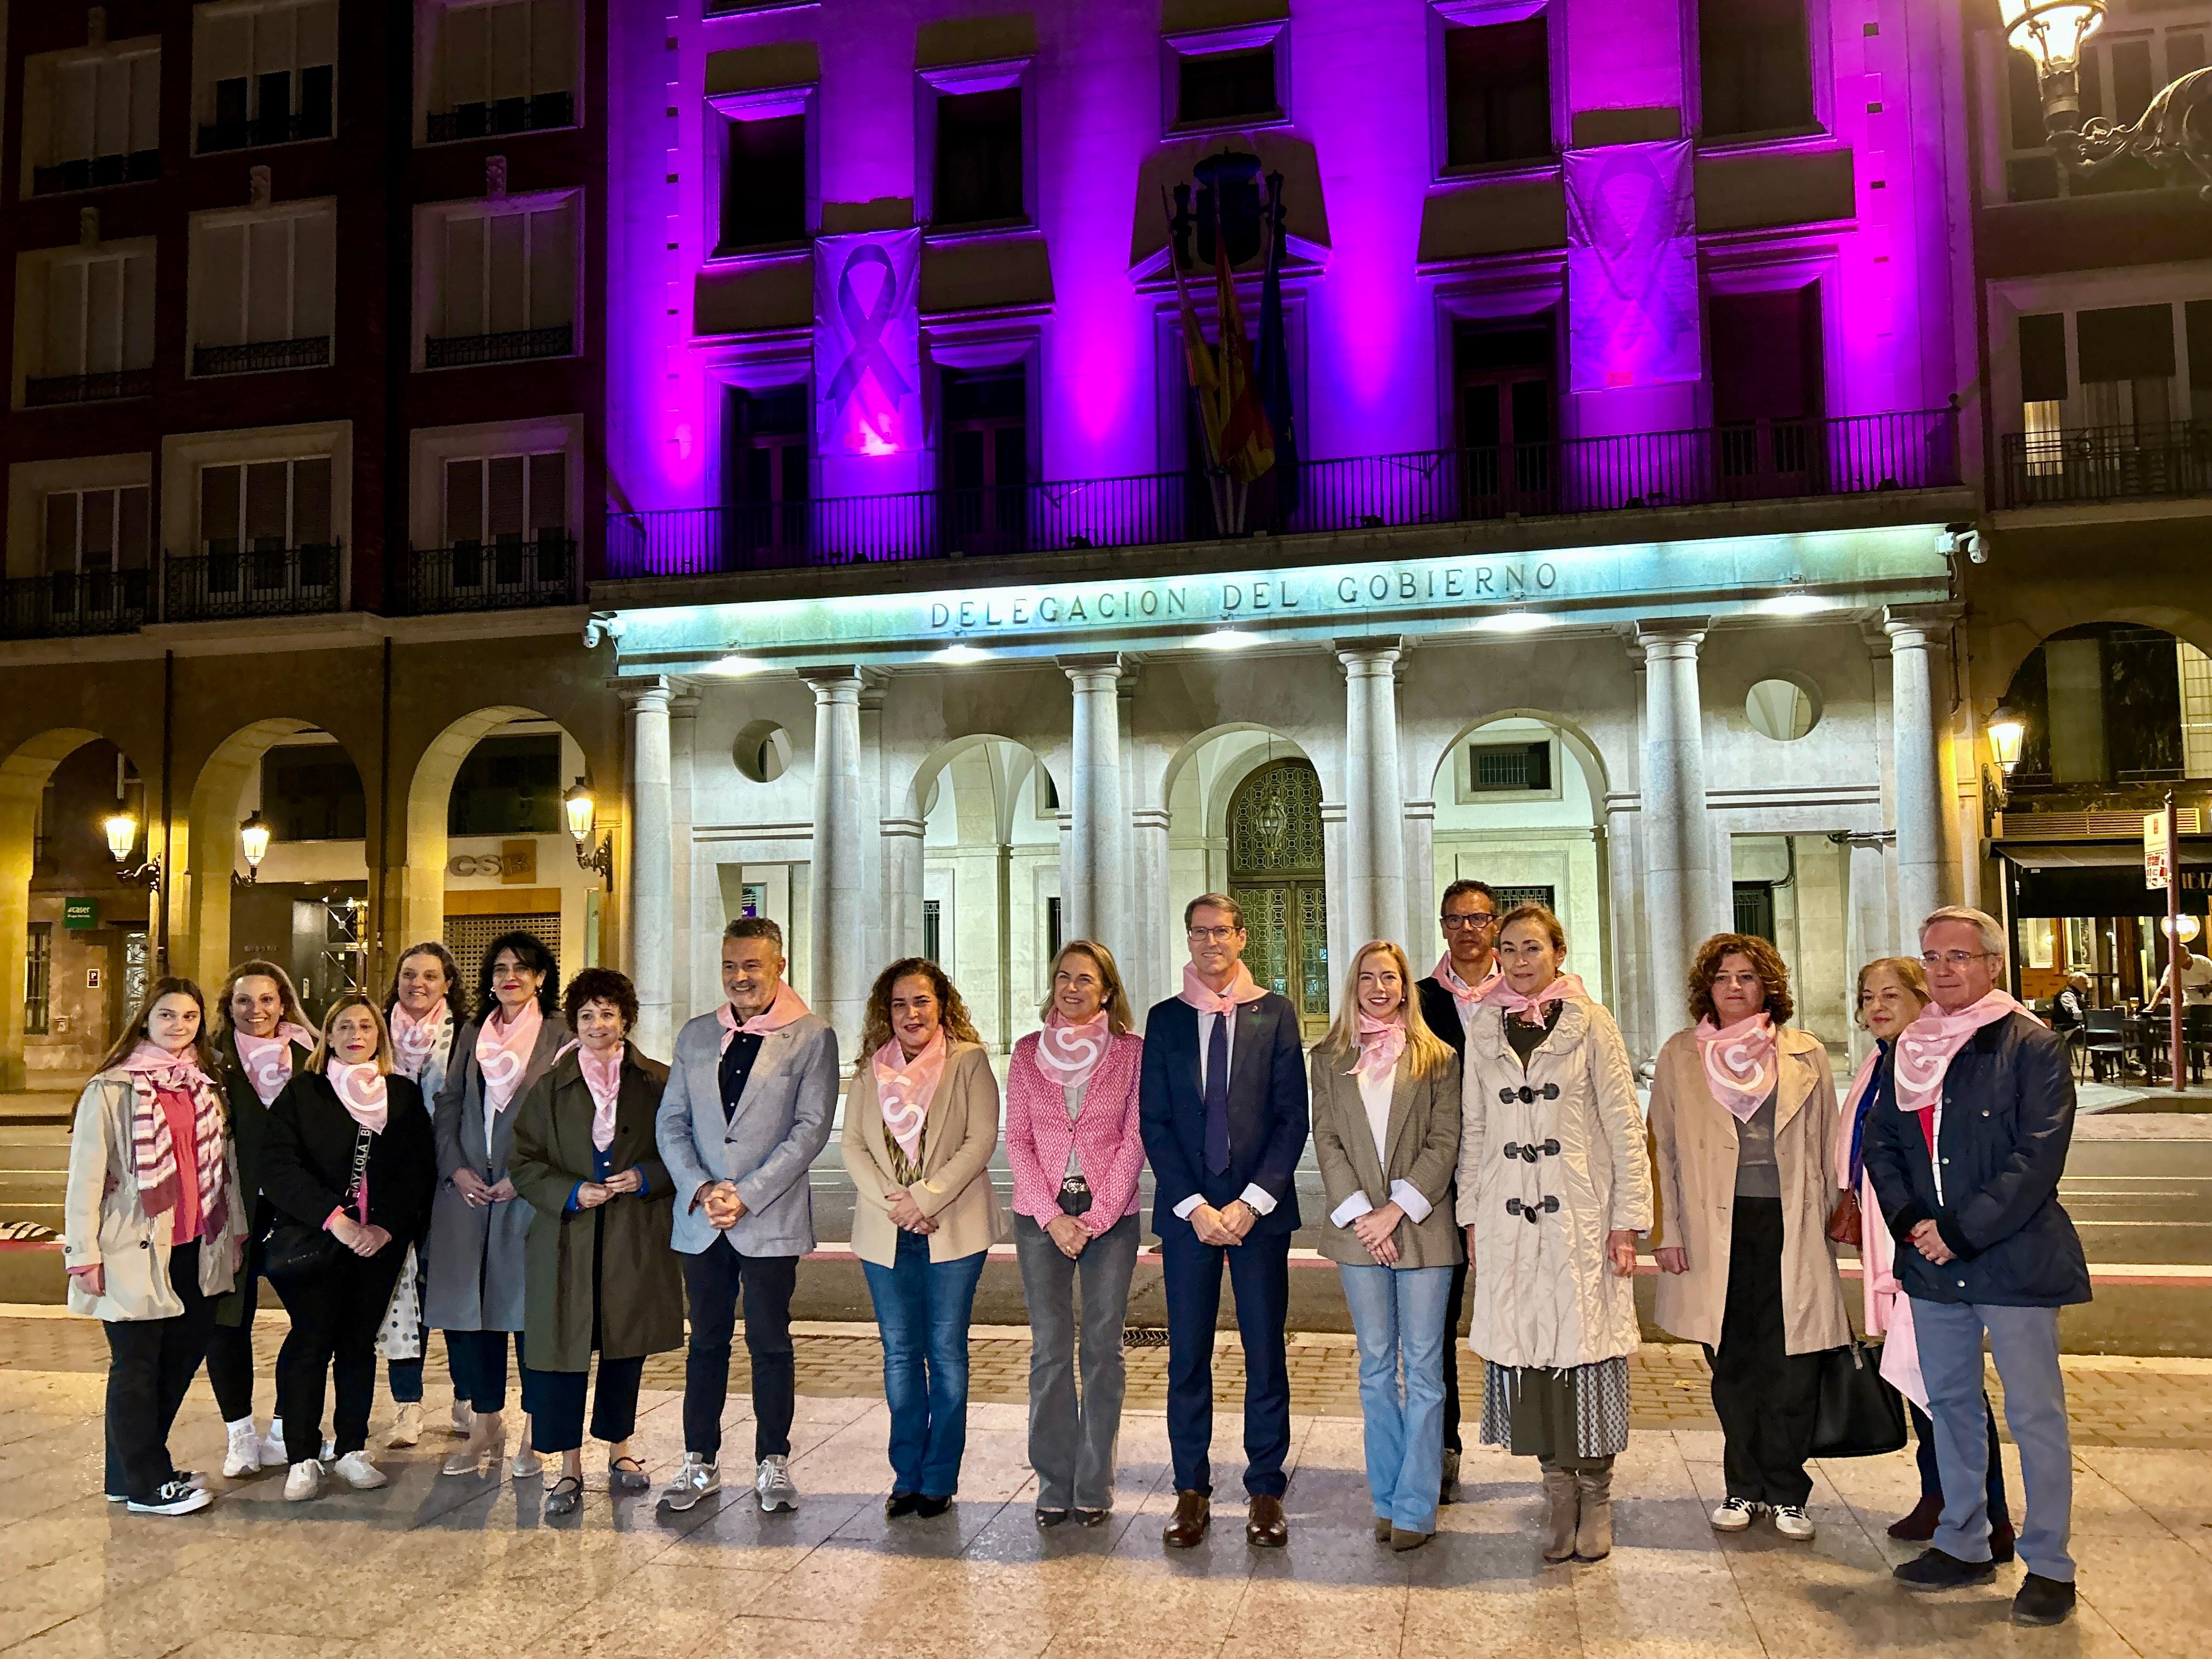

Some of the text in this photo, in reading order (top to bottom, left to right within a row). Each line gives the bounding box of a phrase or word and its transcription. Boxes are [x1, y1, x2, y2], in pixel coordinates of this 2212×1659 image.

[932, 563, 1556, 629] DELEGACION DEL GOBIERNO
